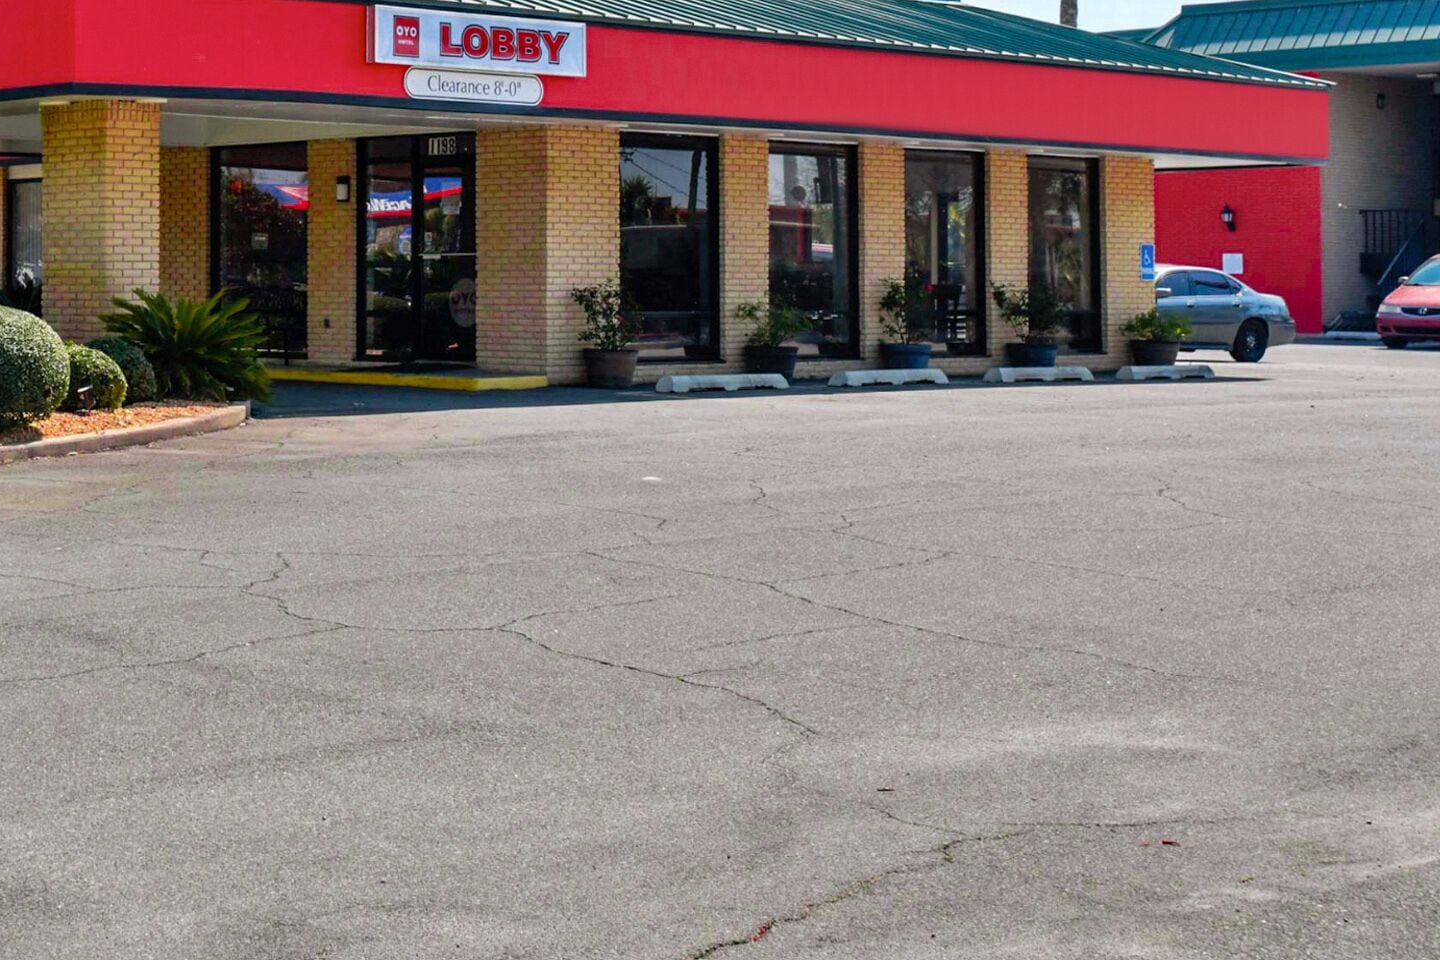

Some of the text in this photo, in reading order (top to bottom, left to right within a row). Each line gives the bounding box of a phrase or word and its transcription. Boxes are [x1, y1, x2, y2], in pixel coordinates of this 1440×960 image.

[396, 25, 417, 38] OYO
[440, 21, 570, 65] LOBBY
[427, 75, 490, 96] Clearance
[428, 137, 456, 155] 1198
